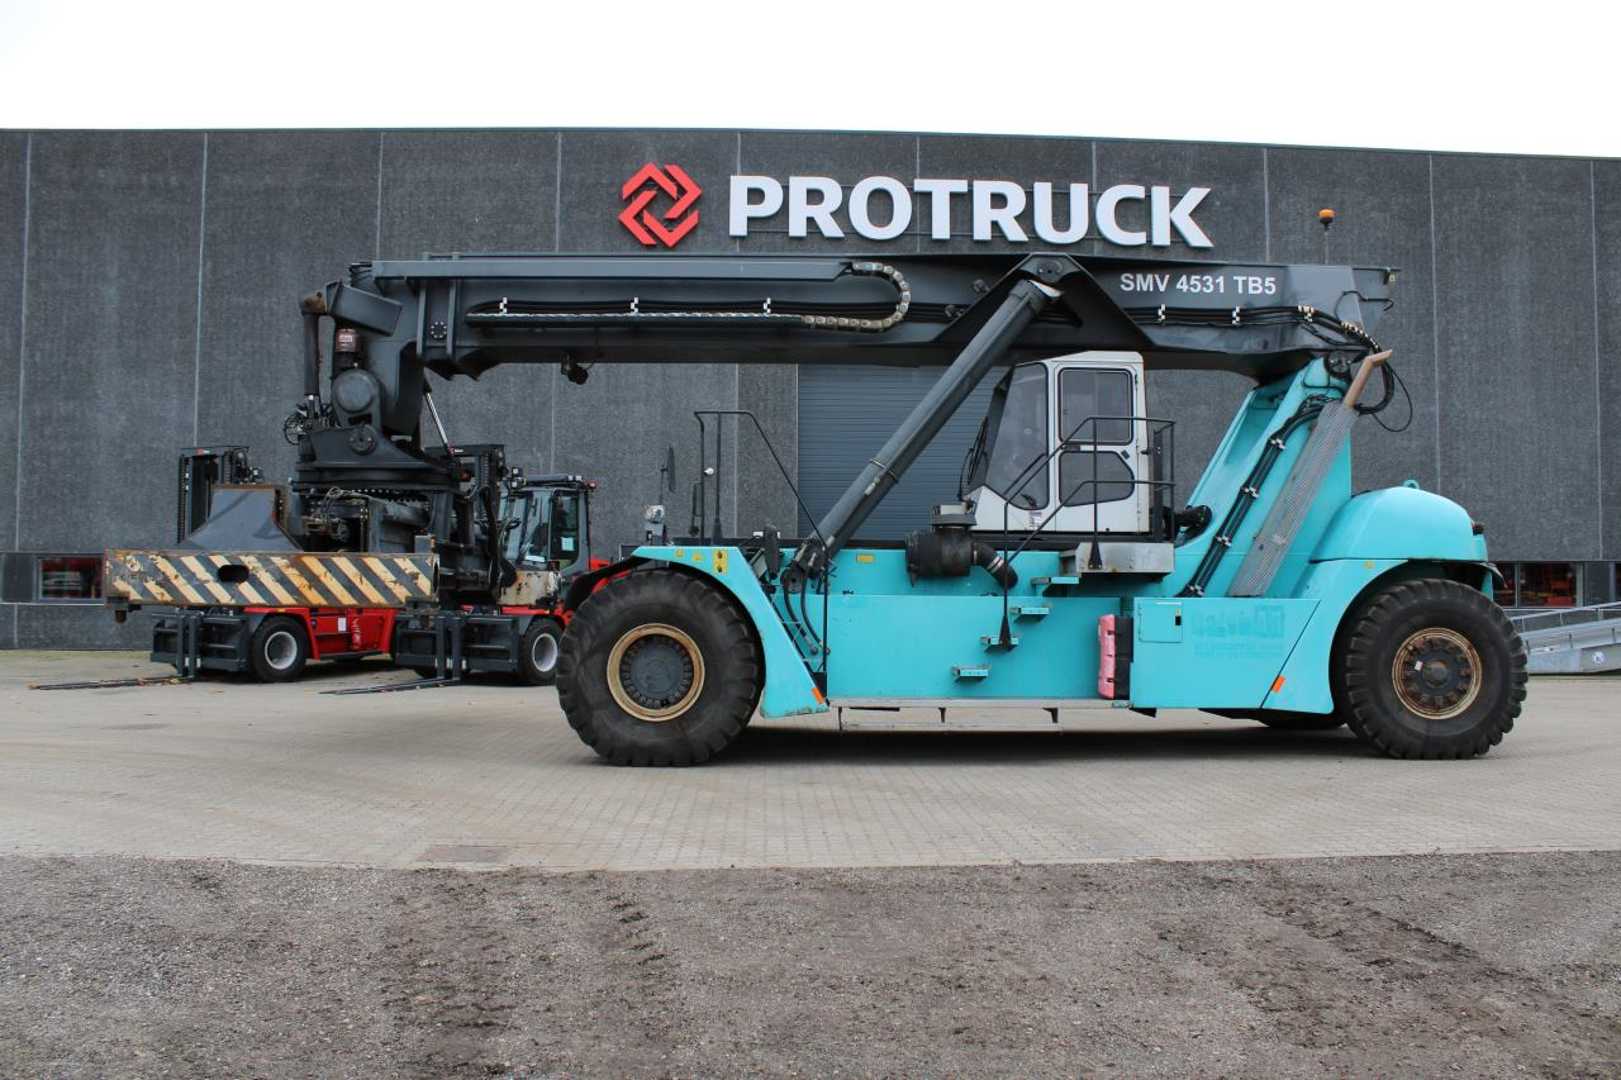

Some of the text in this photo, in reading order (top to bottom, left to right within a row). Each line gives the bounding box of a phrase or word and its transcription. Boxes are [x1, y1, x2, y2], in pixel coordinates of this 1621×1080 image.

[729, 175, 1214, 249] PROTRUCK
[1120, 273, 1276, 295] SMV 4531 TB5
